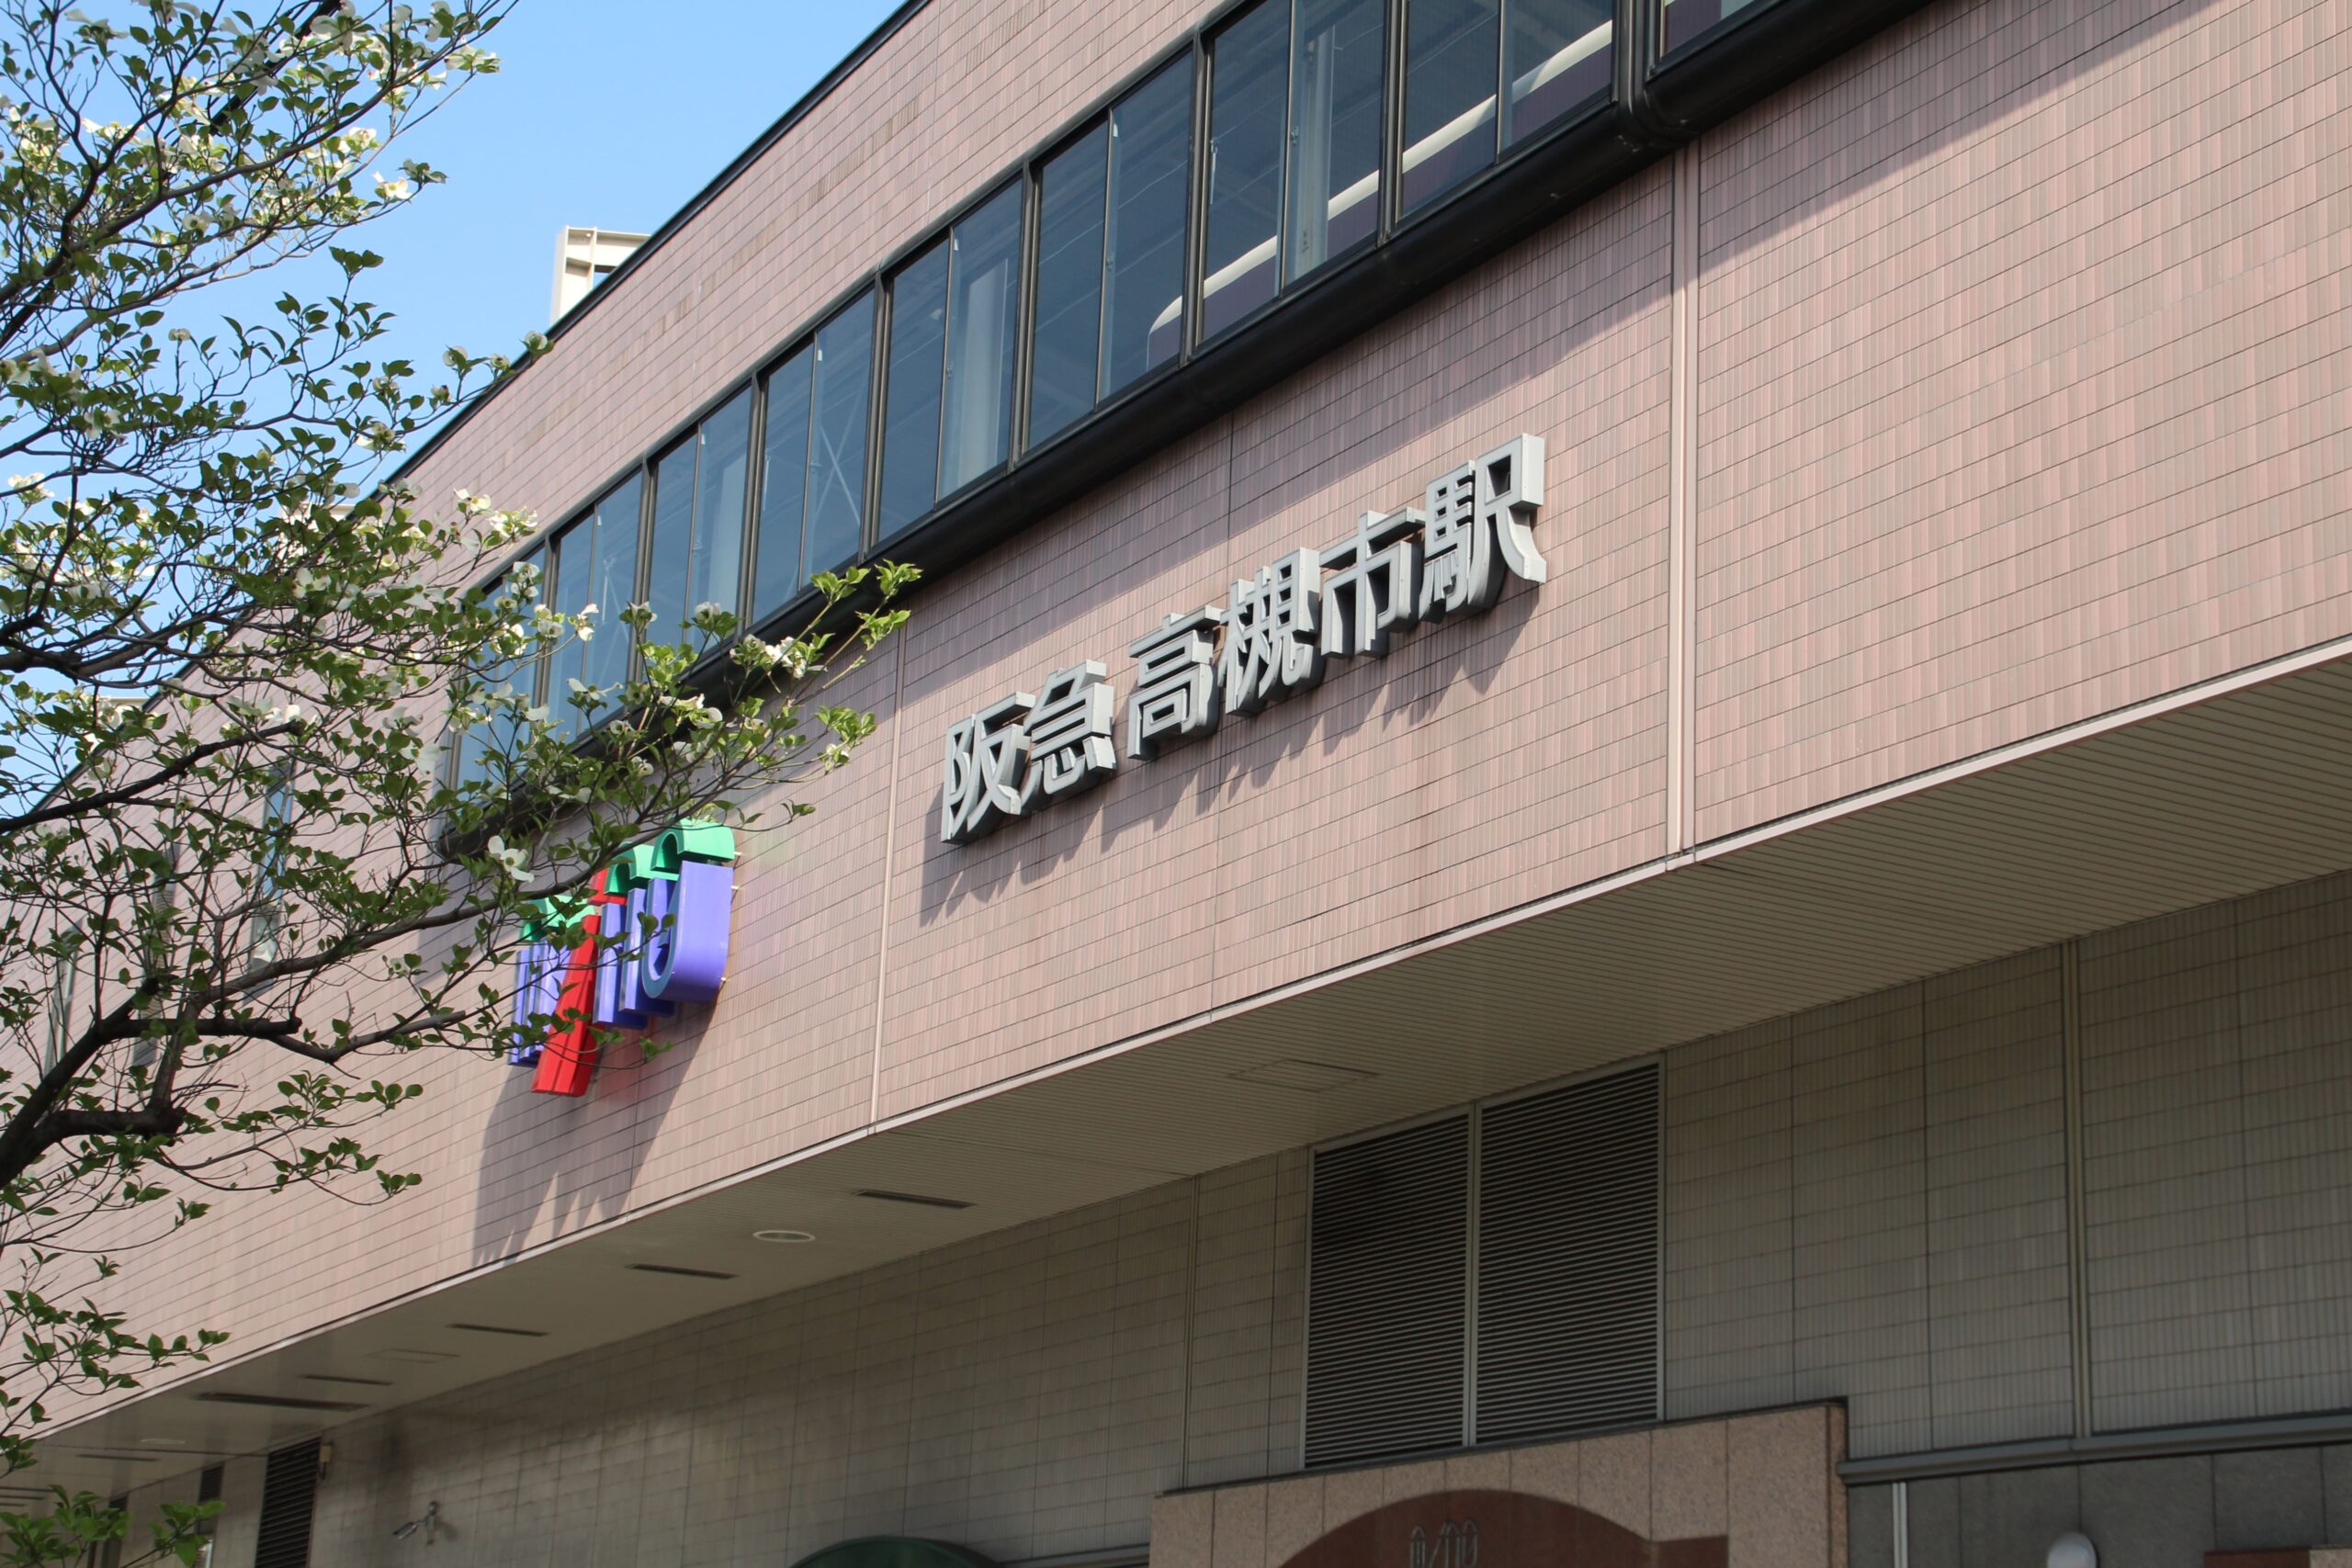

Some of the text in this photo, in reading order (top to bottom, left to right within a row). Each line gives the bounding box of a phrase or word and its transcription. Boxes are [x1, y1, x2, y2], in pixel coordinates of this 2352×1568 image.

[941, 433, 1546, 843] 阪急高槻市駅
